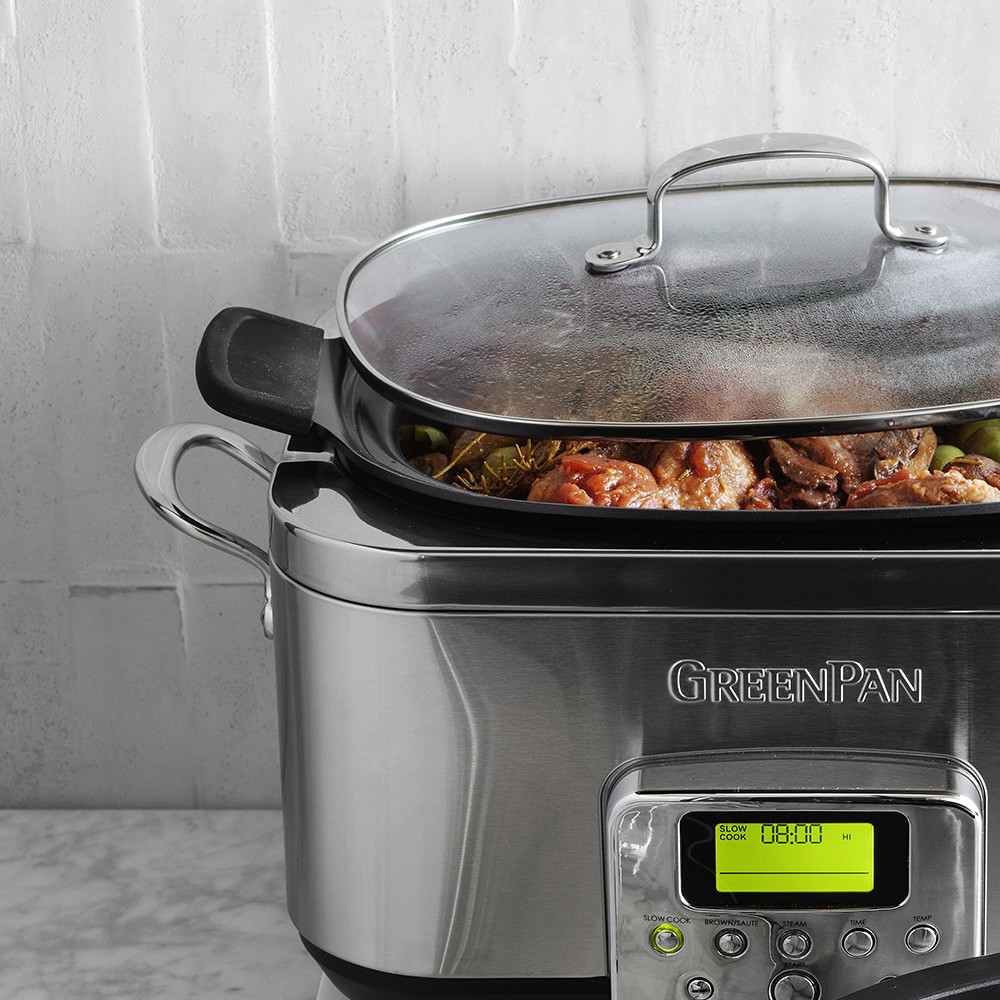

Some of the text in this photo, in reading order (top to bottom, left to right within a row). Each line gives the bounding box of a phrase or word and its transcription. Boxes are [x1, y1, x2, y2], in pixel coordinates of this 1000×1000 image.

[667, 658, 922, 703] GREENPAN
[719, 824, 747, 833] SLOW
[719, 833, 747, 841] COOK
[760, 823, 823, 845] 08:00
[643, 914, 691, 925] SLOW COOK
[850, 918, 867, 926] TIME
[913, 914, 933, 922] TEMP
[782, 920, 808, 928] STEAM
